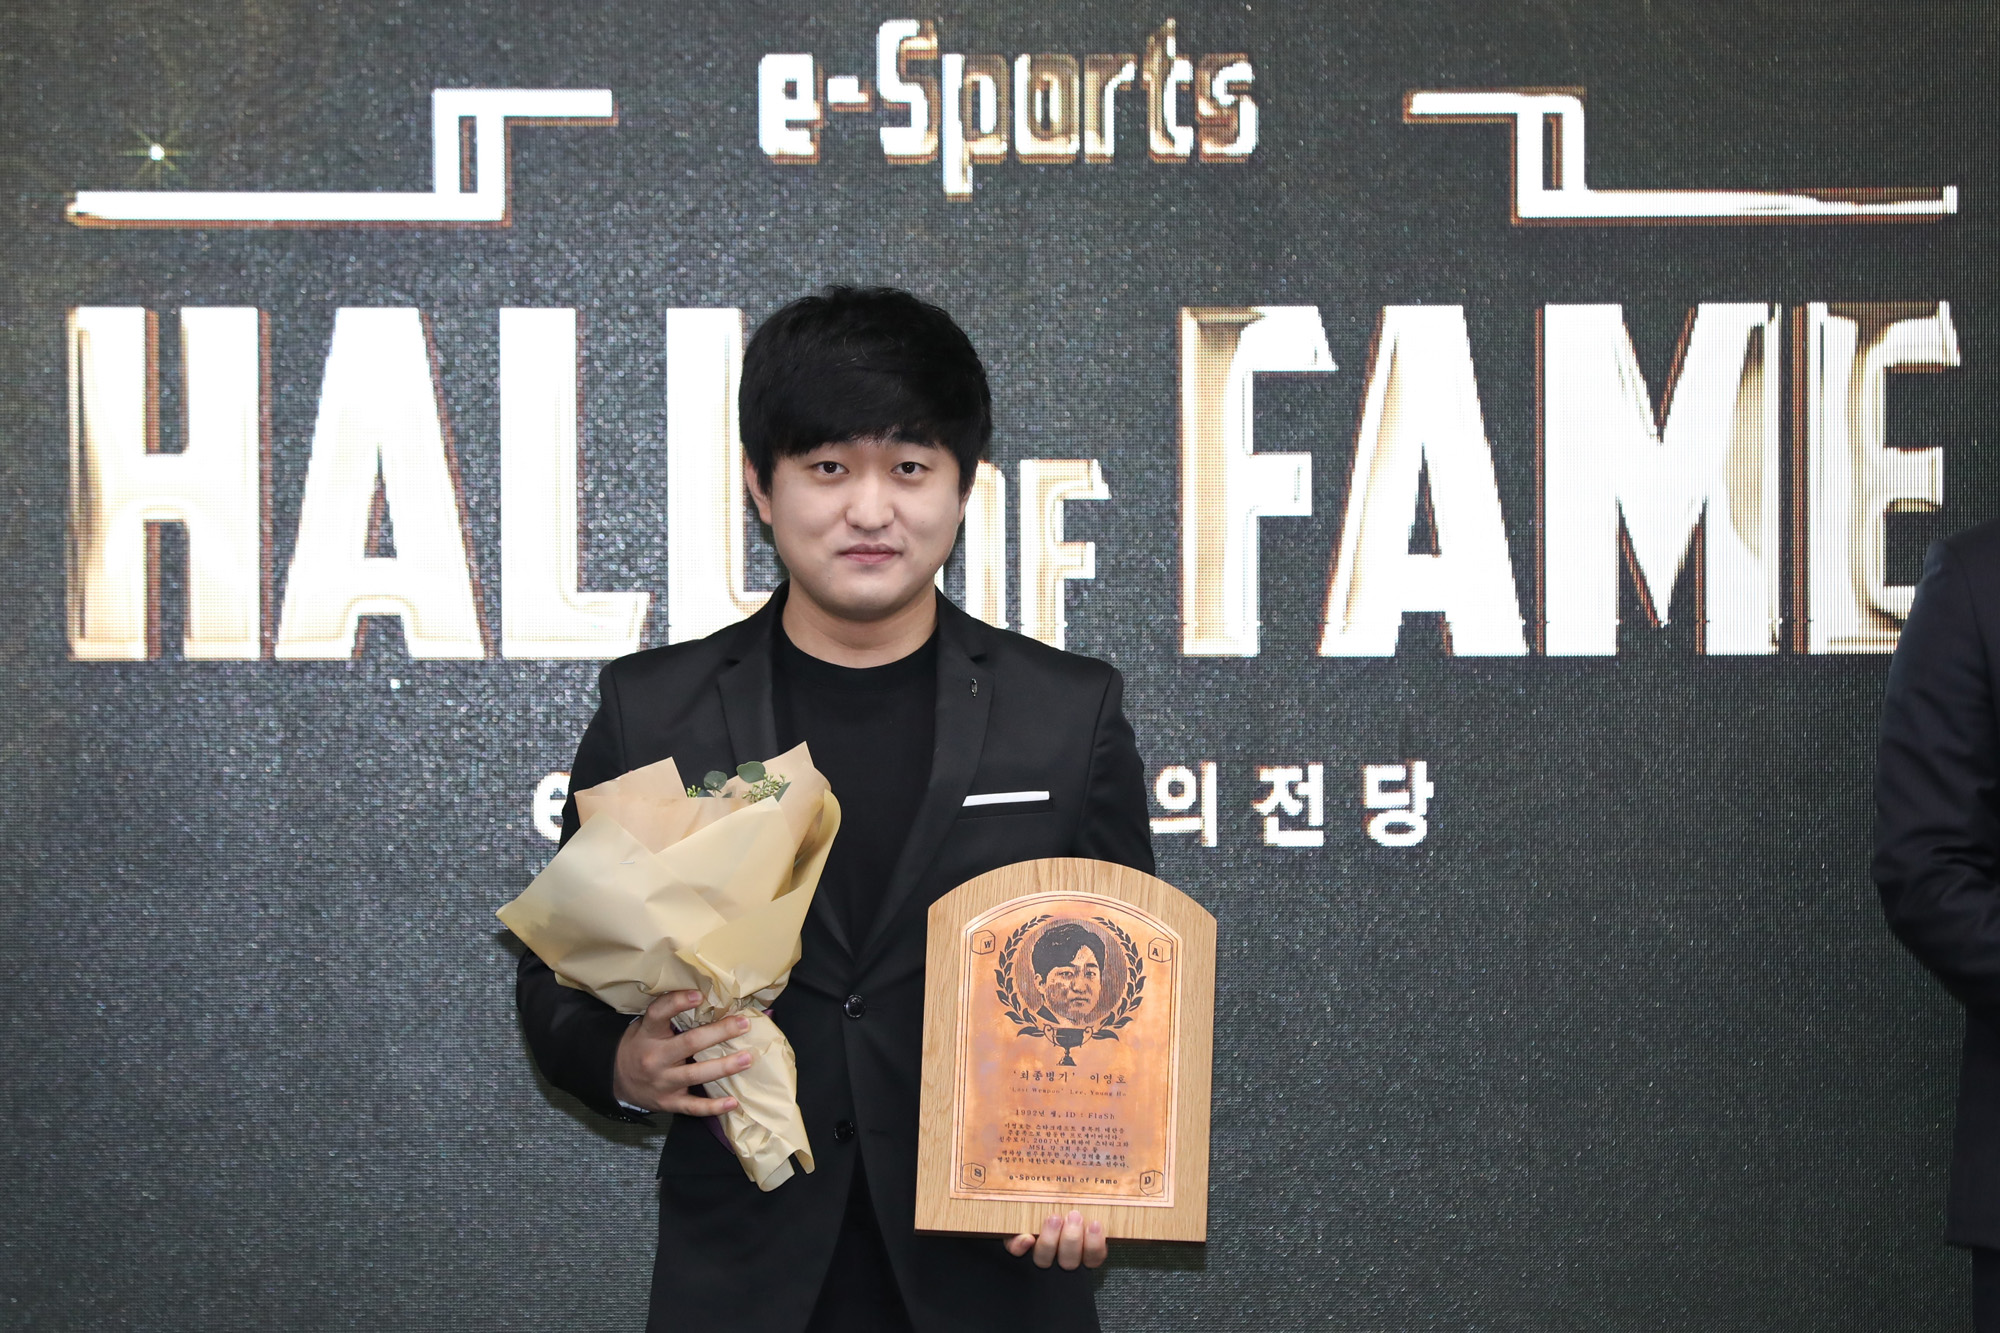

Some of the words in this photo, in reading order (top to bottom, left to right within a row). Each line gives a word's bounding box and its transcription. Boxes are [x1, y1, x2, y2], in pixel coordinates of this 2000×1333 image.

[758, 18, 1260, 201] e-Sports
[68, 307, 788, 662] HALL
[1177, 301, 1961, 658] FAME
[984, 940, 992, 949] W
[1152, 947, 1159, 956] A
[1089, 1072, 1127, 1085] 이영호
[1009, 1174, 1051, 1183] e-Sports
[1056, 1175, 1075, 1183] Hall
[1094, 1177, 1118, 1185] Fame
